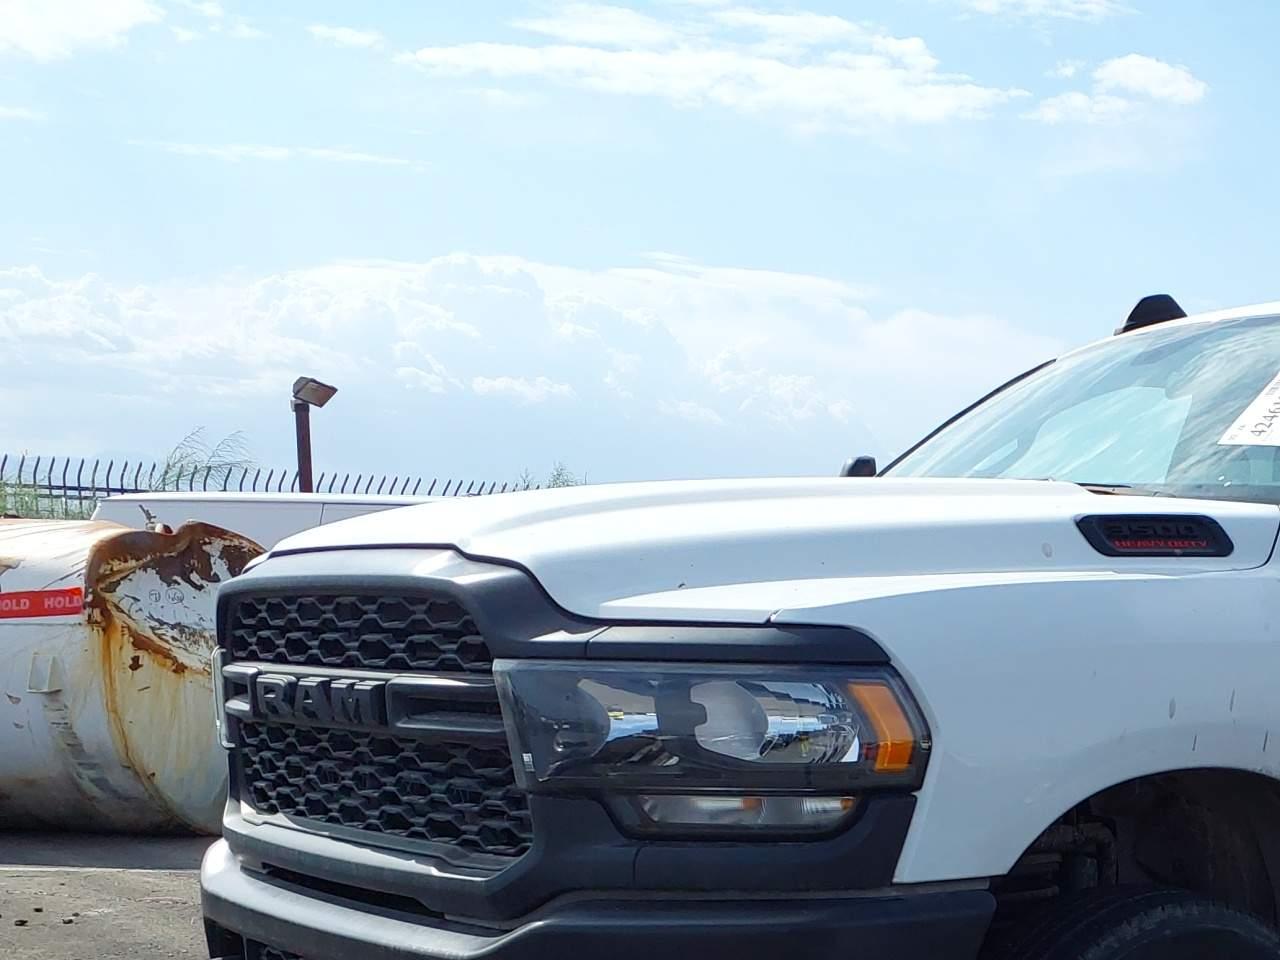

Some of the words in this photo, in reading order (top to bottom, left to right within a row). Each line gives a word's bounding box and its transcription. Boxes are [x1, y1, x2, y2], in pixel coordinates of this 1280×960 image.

[1113, 538, 1164, 549] HEAVY
[1167, 539, 1208, 549] DUTY
[0, 598, 30, 611] OLD
[43, 596, 82, 609] HOLD
[256, 674, 385, 726] RAM
